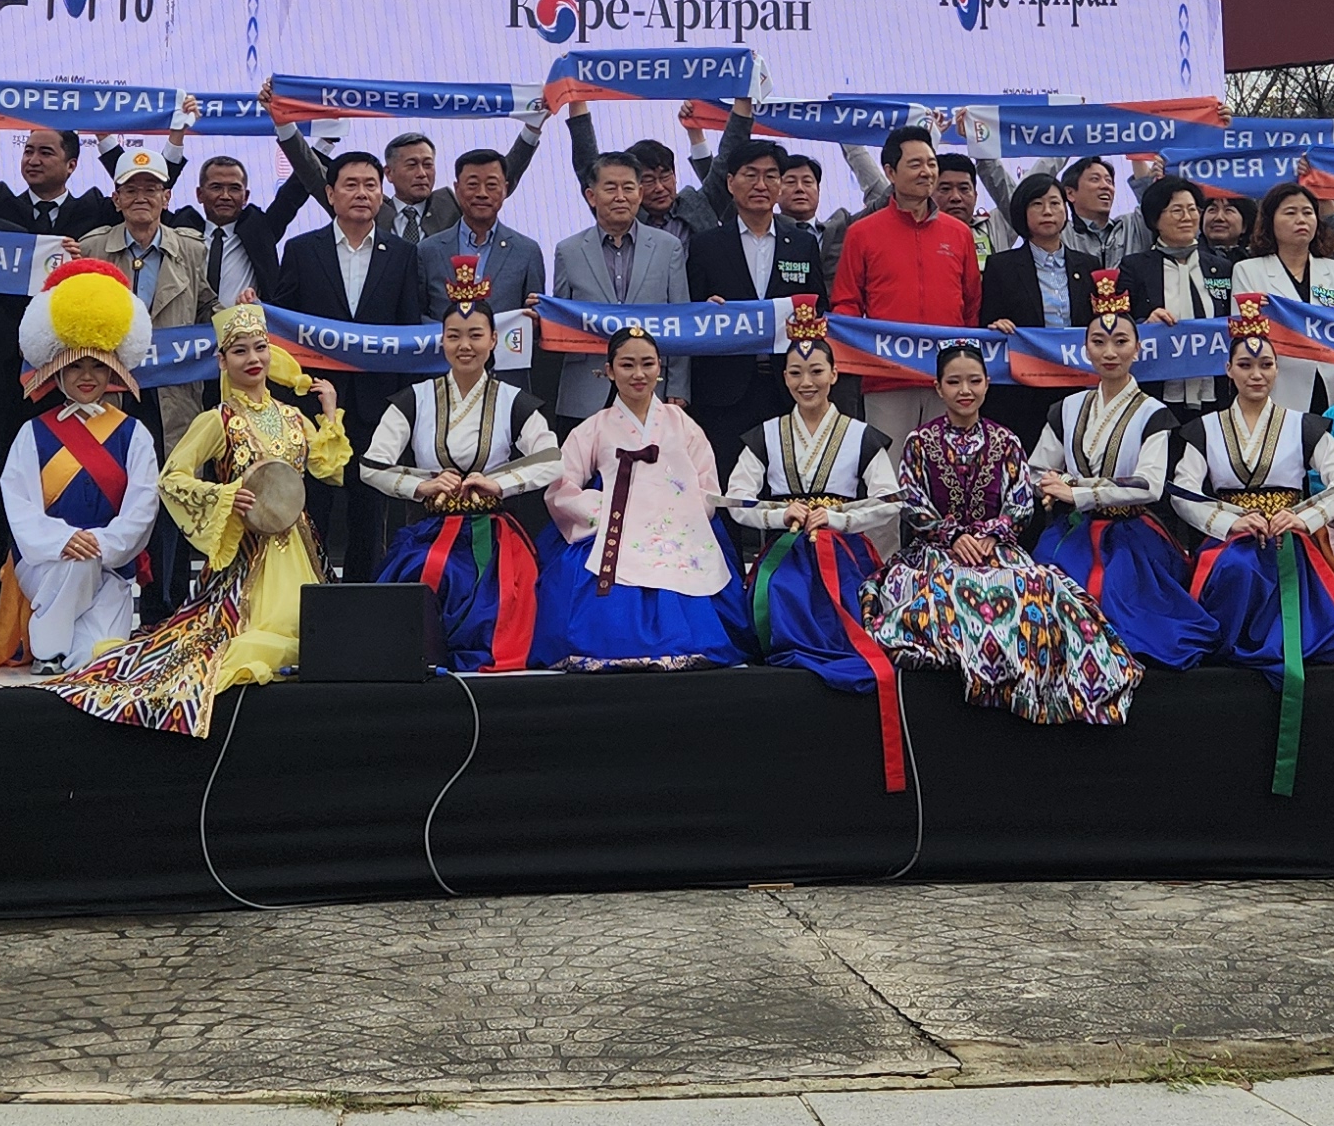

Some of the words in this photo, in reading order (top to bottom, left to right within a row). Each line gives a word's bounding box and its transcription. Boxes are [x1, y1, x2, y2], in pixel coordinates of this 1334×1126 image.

[577, 59, 670, 81] КОРЕЯ
[682, 56, 747, 79] УРА!
[93, 90, 165, 113] УРА!
[321, 87, 419, 109] КОРЕЯ
[433, 93, 503, 113] УРА!
[751, 102, 822, 123] ОРЕЯ
[833, 105, 899, 131] УРА!
[1010, 124, 1074, 145] УРА!
[1086, 120, 1176, 144] КОРЕЯ
[1178, 157, 1264, 179] КОРЕЯ
[778, 260, 810, 273] 국회의원
[694, 311, 764, 337] УРА!
[172, 338, 217, 363] УР
[298, 324, 400, 355] КОРЕЯ
[875, 334, 935, 359] КОР
[1170, 331, 1229, 358] УРА
